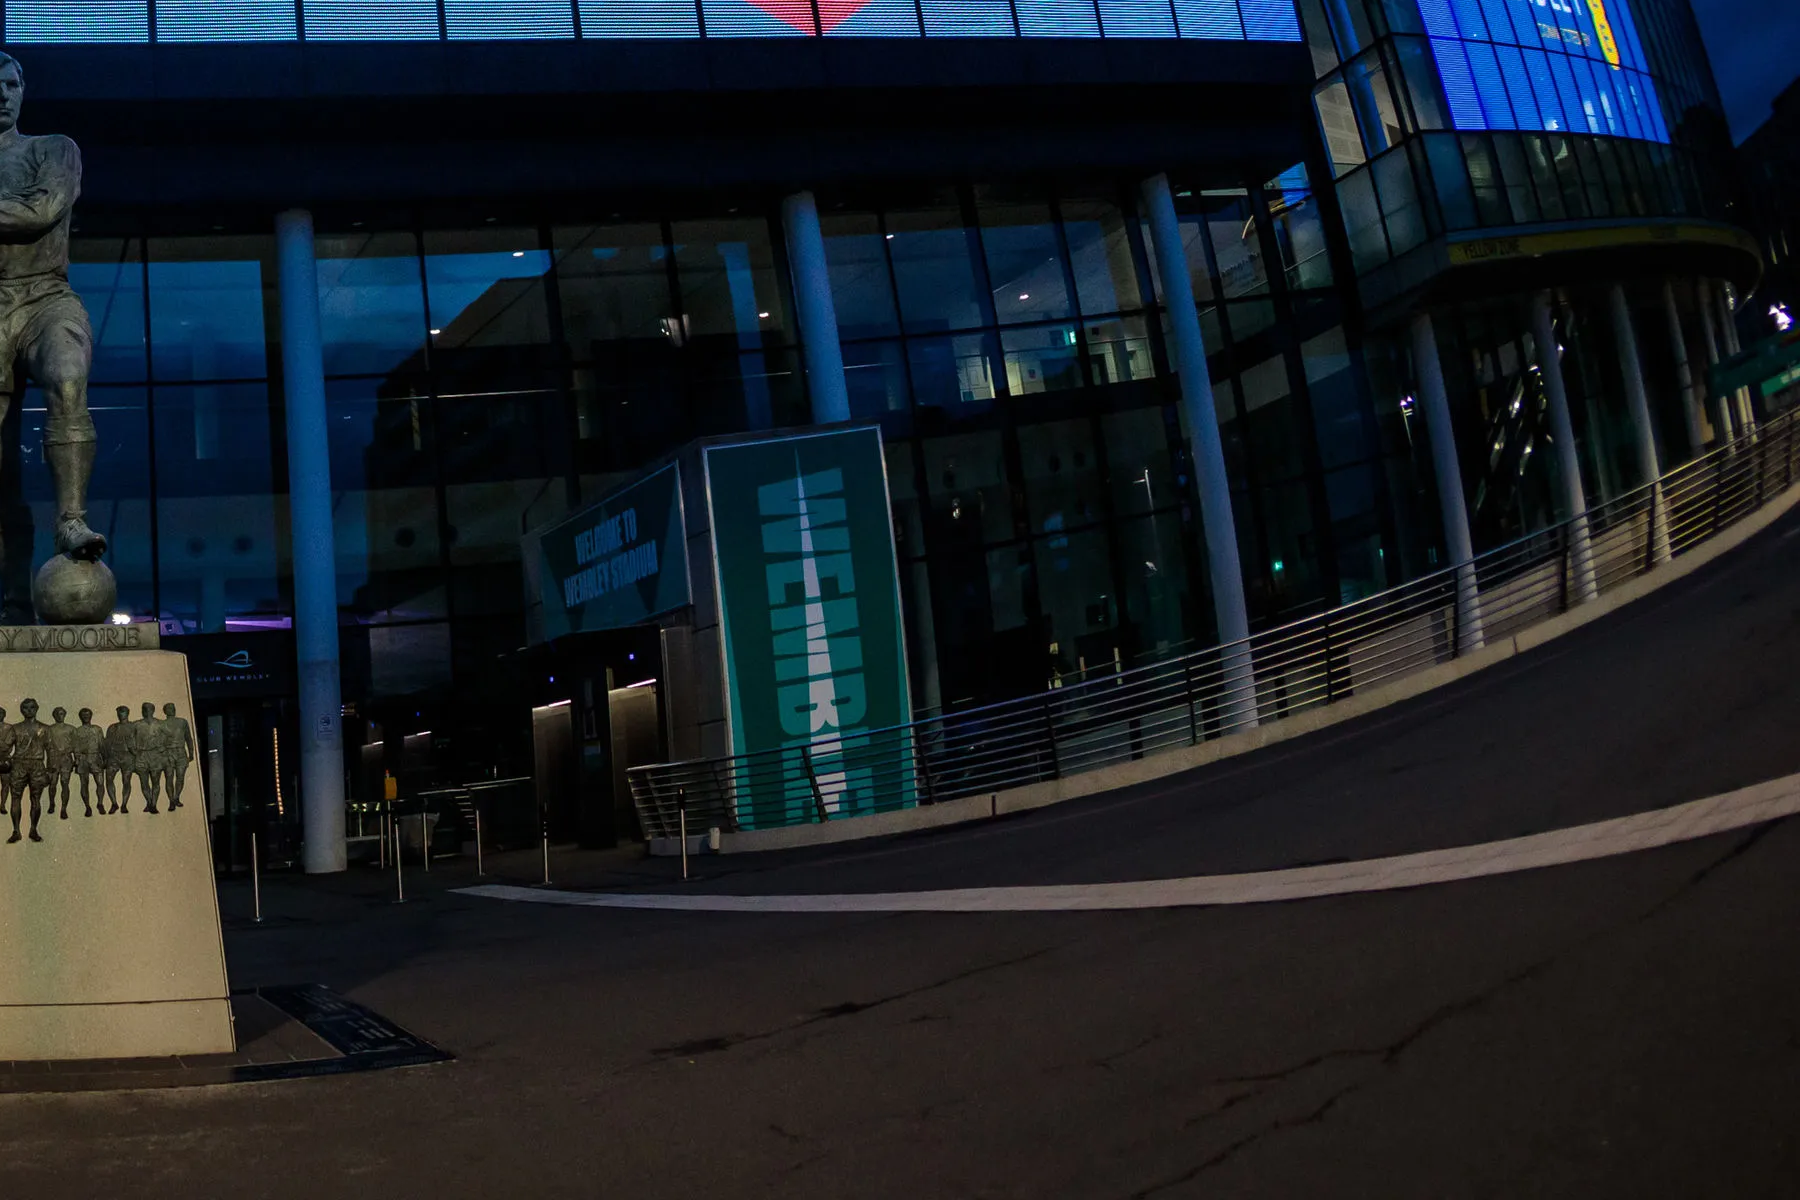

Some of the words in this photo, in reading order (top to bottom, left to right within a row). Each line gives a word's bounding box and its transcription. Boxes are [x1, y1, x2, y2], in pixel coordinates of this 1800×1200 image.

[575, 514, 623, 566] WELCOME
[622, 508, 638, 543] TO
[564, 561, 610, 608] WEMBLEY
[611, 540, 658, 590] STADIUM
[30, 627, 141, 650] MOORE
